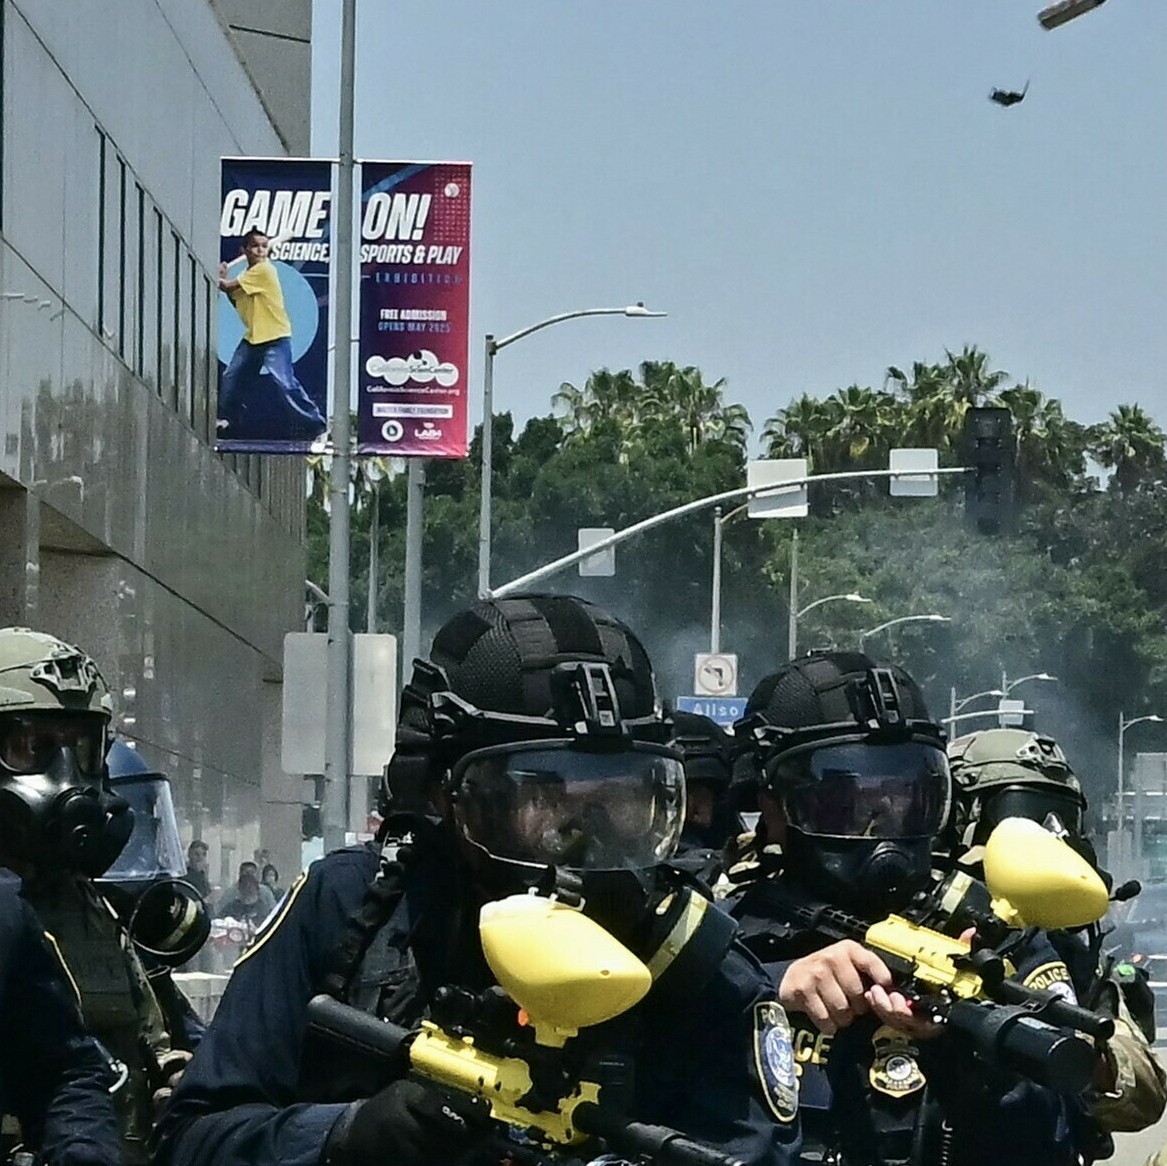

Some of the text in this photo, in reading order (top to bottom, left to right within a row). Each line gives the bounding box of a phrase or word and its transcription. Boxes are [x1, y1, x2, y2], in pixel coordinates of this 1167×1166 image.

[220, 188, 432, 241] GAME ON!
[270, 242, 463, 265] SCIENCE, SPORTS & PLAY
[407, 322, 426, 332] MAY
